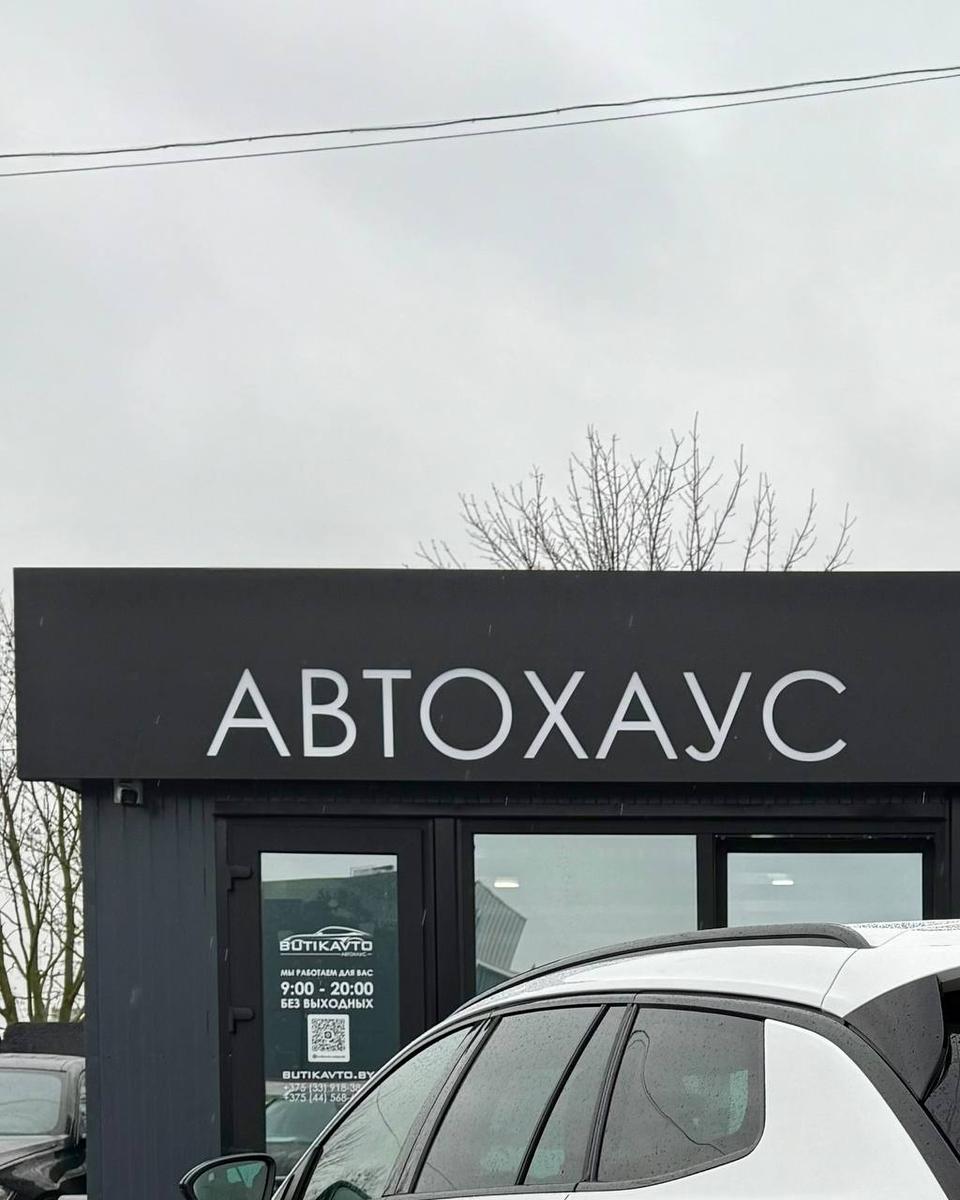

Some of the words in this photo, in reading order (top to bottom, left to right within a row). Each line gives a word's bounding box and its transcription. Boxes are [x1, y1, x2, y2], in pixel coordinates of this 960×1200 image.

[206, 668, 848, 762] АВТОХАУС
[279, 940, 373, 951] BUTIKAVTO
[280, 969, 295, 977] МЫ
[296, 969, 338, 977] РАБОТАЕМ
[338, 969, 355, 977] ДЛЯ
[356, 969, 374, 977] ВАС
[280, 981, 314, 995] 9:00
[330, 981, 374, 995] 20:00
[280, 998, 300, 1009] БЕЗ
[303, 998, 374, 1010] ВЫХОДНЫХ
[282, 1071, 375, 1080] BUTIKAVTO.BY
[309, 1083, 327, 1094] (33)
[283, 1093, 306, 1102] +375
[309, 1093, 327, 1104] (44)
